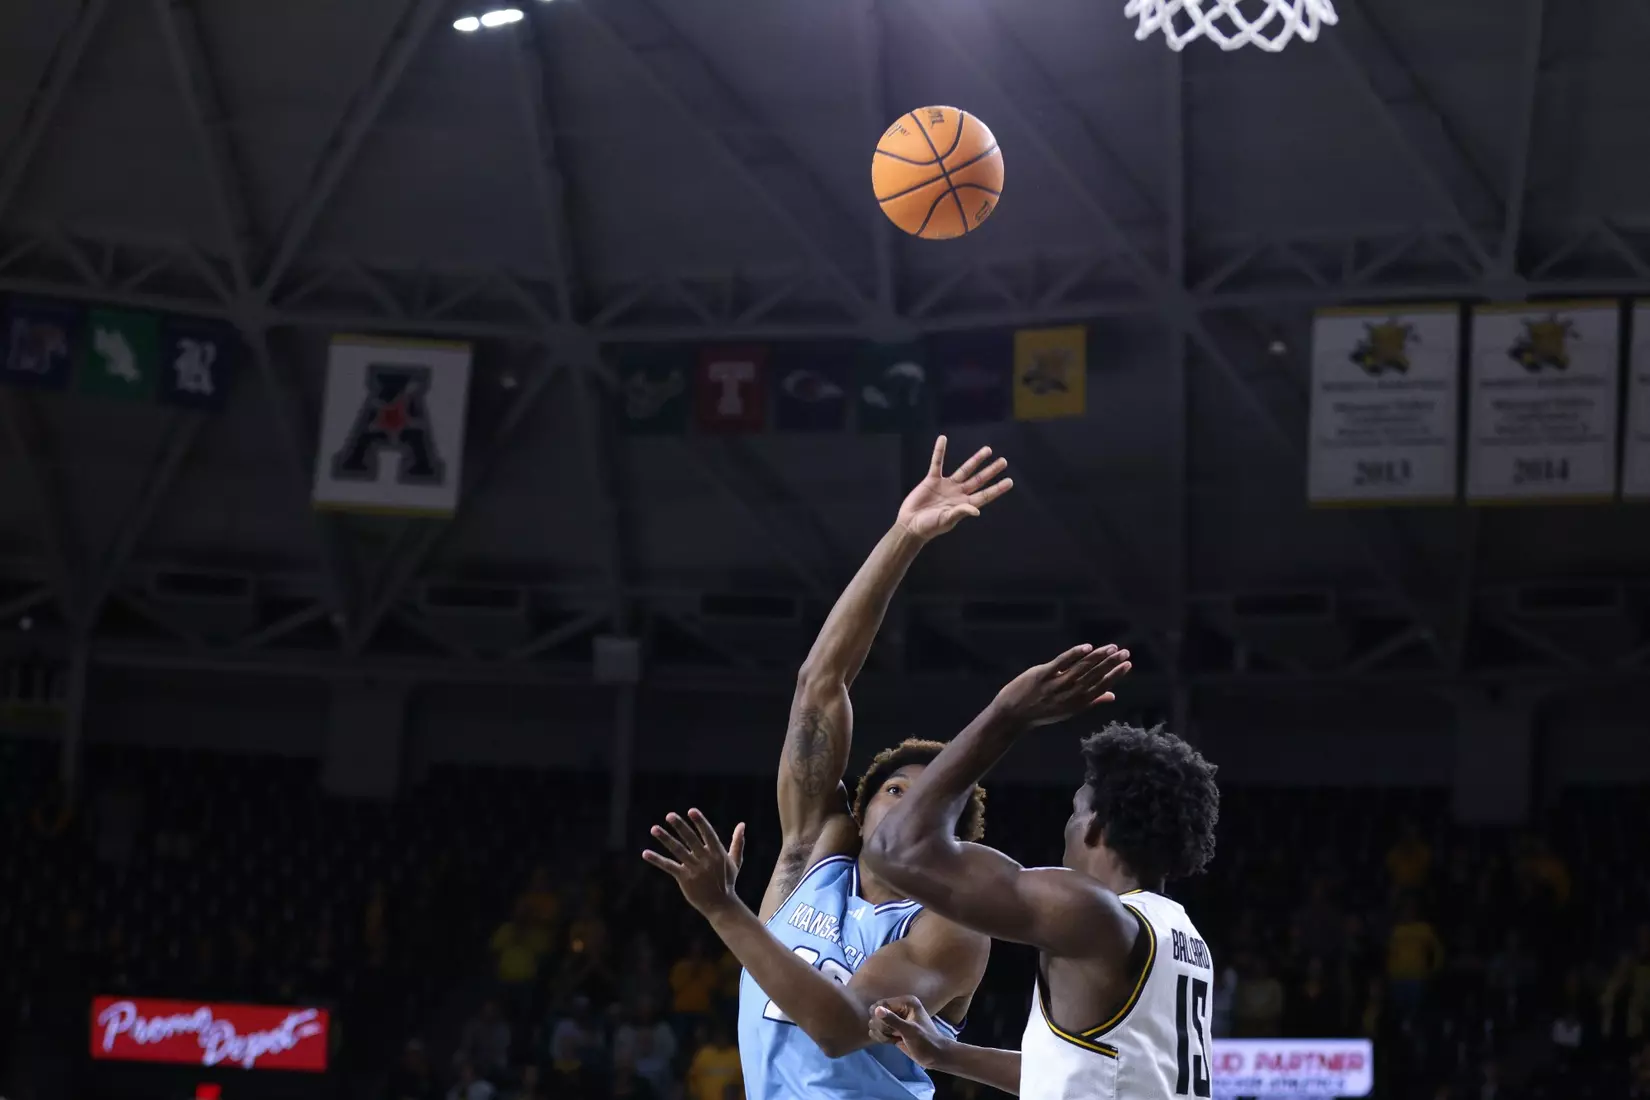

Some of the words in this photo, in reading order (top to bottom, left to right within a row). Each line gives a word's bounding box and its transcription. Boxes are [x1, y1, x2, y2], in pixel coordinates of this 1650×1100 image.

[707, 360, 757, 416] T
[331, 362, 446, 486] A
[1353, 459, 1413, 486] 2013
[1512, 456, 1571, 484] 2014
[788, 901, 843, 948] KANSA
[1171, 928, 1210, 970] BALLARD
[1176, 974, 1211, 1098] 15
[1254, 1052, 1365, 1071] PARTNER
